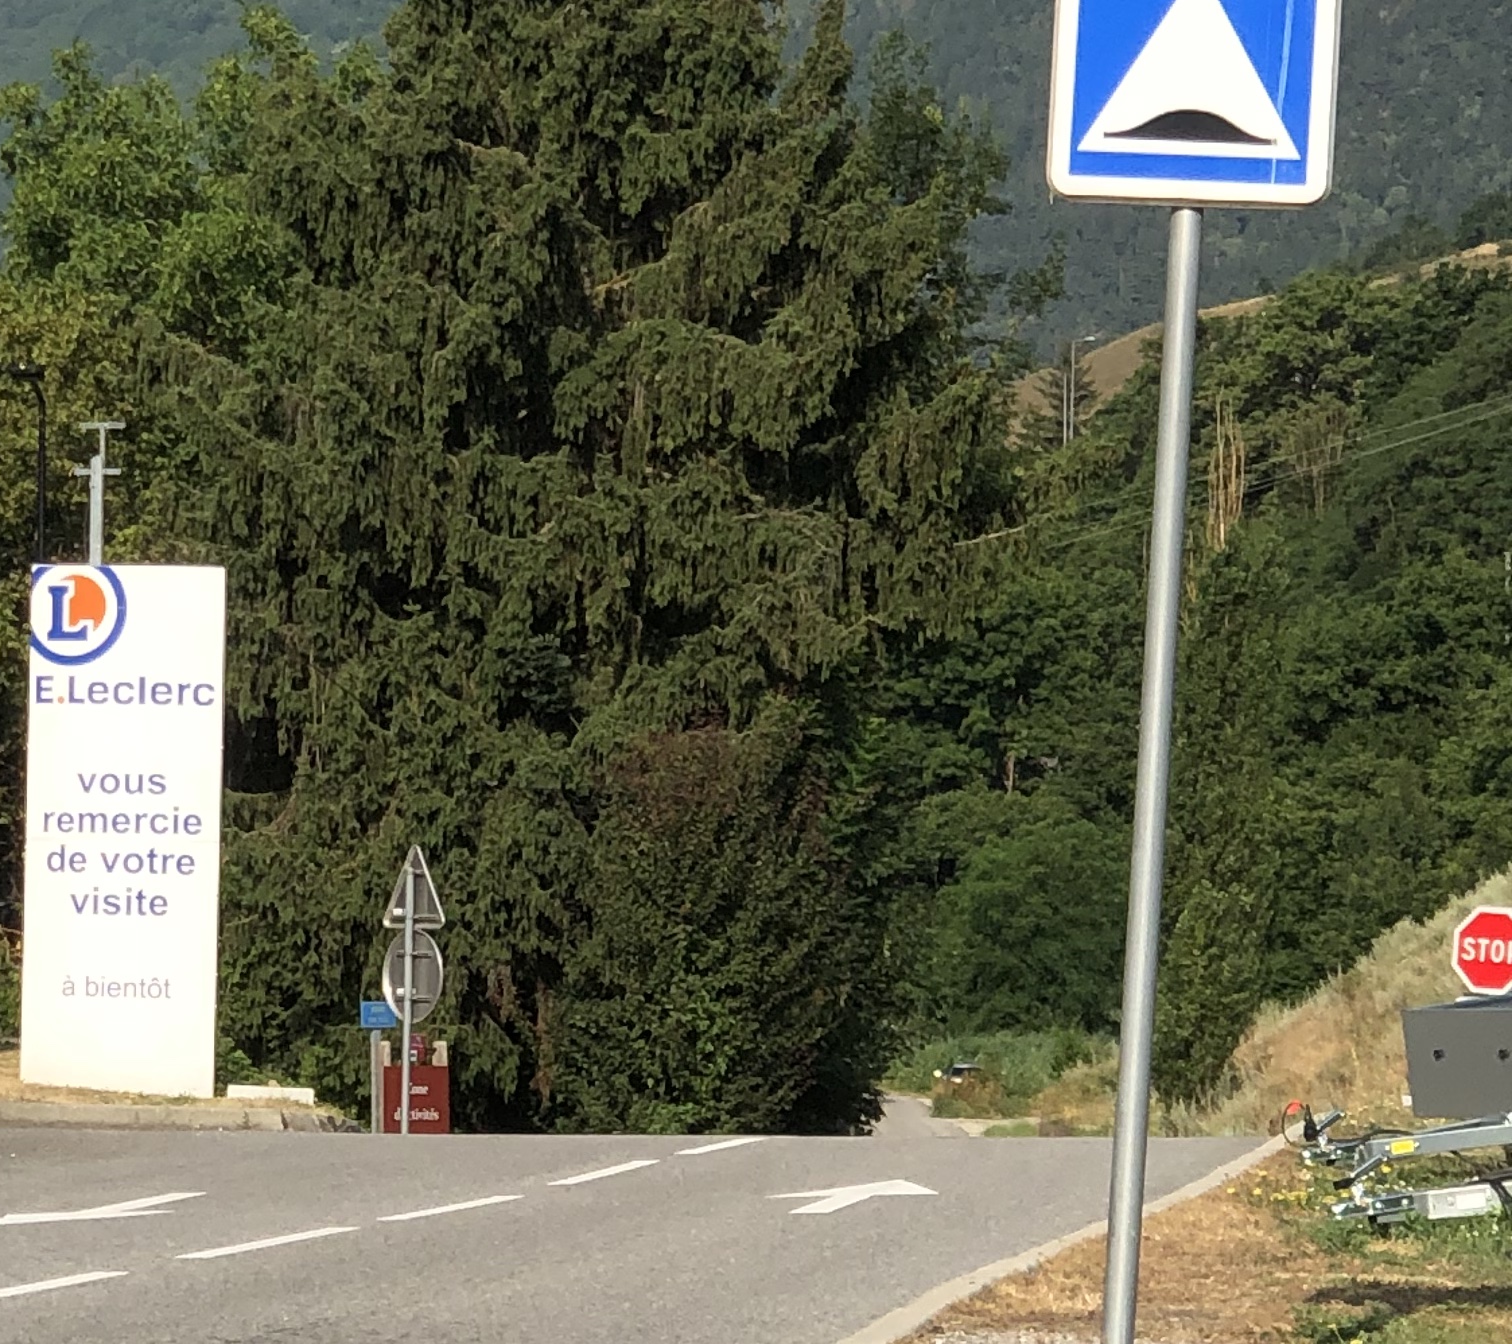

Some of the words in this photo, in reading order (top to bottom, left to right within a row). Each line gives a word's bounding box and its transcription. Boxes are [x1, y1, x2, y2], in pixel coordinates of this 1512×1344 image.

[34, 674, 216, 707] E.Leclerc
[77, 772, 167, 796] vous
[42, 806, 203, 836] remercie
[46, 844, 87, 873] de
[100, 847, 196, 876] votre
[70, 886, 169, 916] visite
[61, 975, 75, 998] à
[85, 975, 172, 999] bientôt
